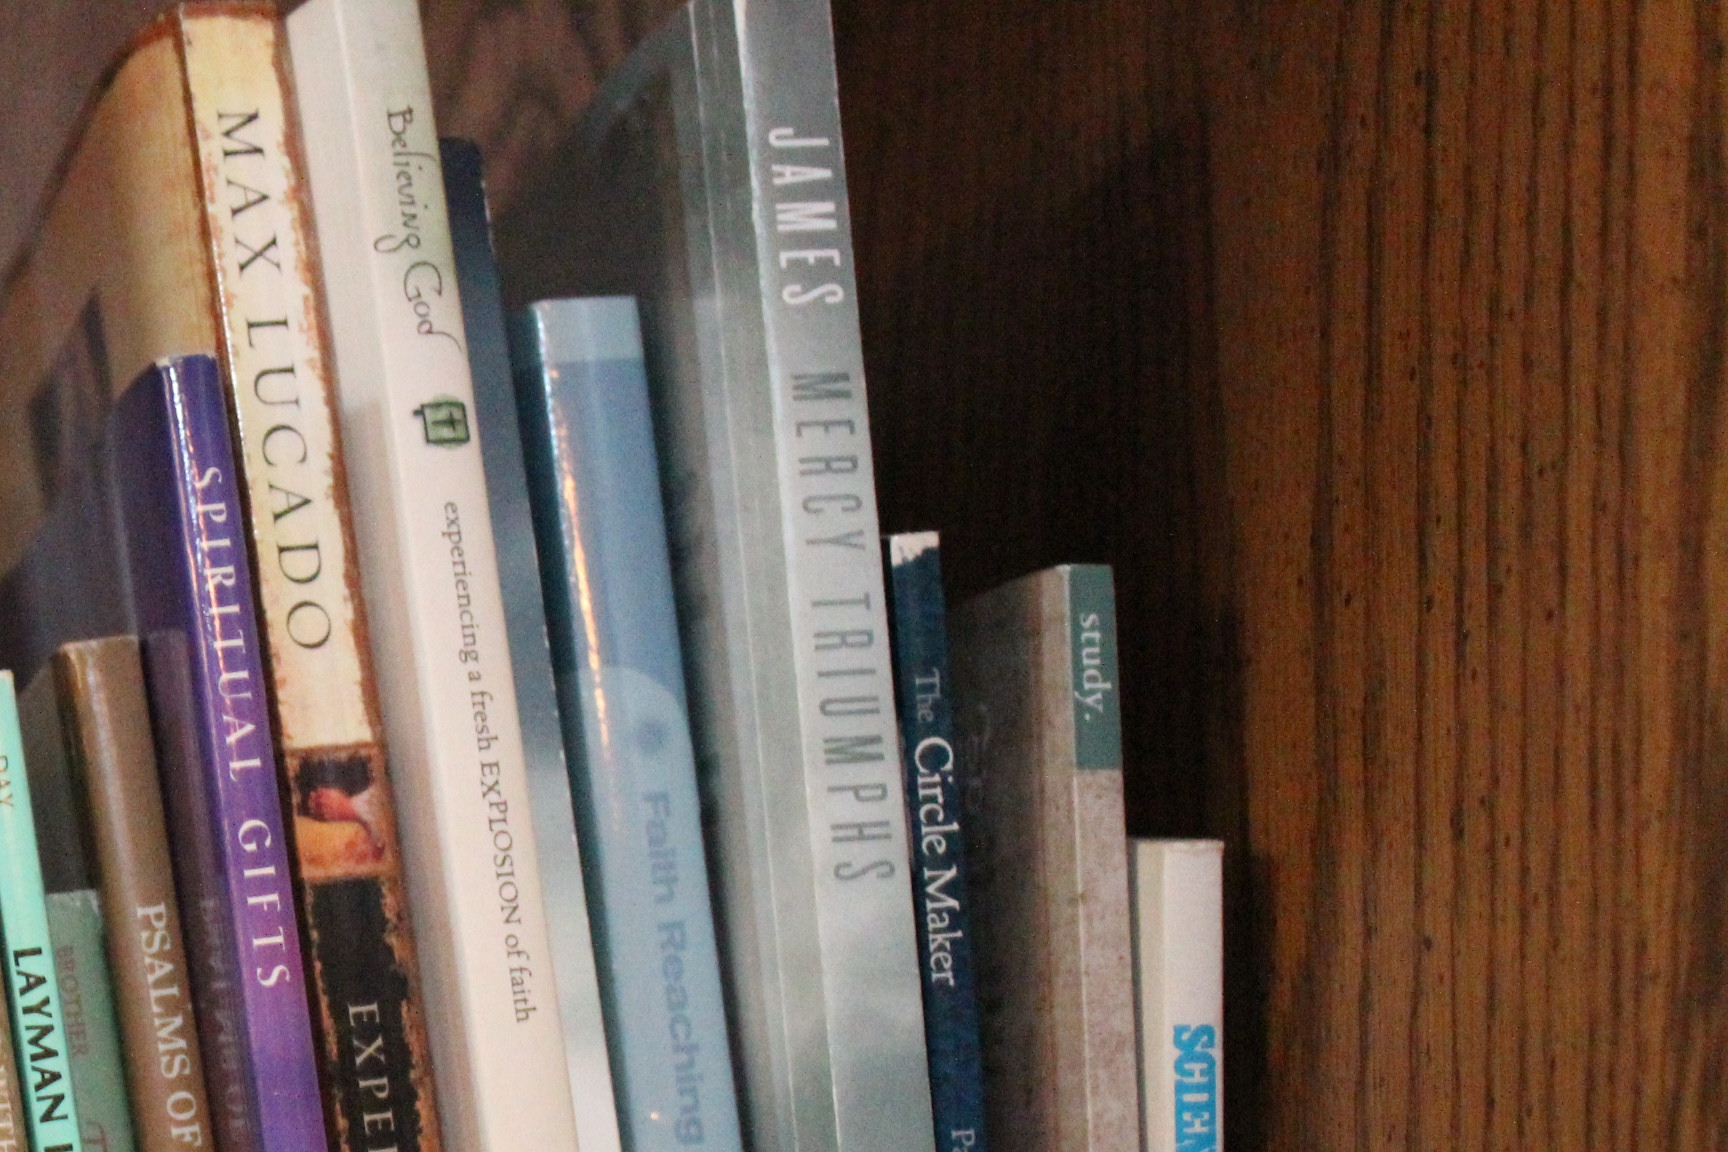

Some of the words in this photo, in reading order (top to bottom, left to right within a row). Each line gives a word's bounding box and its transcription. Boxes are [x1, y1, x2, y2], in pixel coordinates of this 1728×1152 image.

[217, 108, 282, 274] MAX
[374, 105, 436, 253] Believing
[768, 127, 844, 304] JAMES
[402, 260, 461, 352] God
[245, 317, 332, 651] LUCADO
[789, 371, 867, 552] MERCY
[443, 500, 480, 664] experiencing
[191, 466, 262, 783] SPIRITUAL
[237, 818, 290, 988] GIFTS
[467, 669, 483, 684] a
[469, 689, 499, 752] fresh
[810, 592, 895, 882] TRIUMPHS
[914, 667, 940, 724] The
[1074, 612, 1113, 721] study.
[479, 760, 523, 924] EXPLOSION
[641, 792, 684, 905] Faith
[914, 736, 961, 856] Circle
[504, 933, 530, 965] of
[508, 966, 538, 1024] faith
[922, 867, 965, 987] Maker
[12, 947, 69, 1124] LAYMAN
[136, 901, 190, 1080] PSALMS
[166, 1091, 203, 1148] OF
[656, 919, 706, 1147] Reaching
